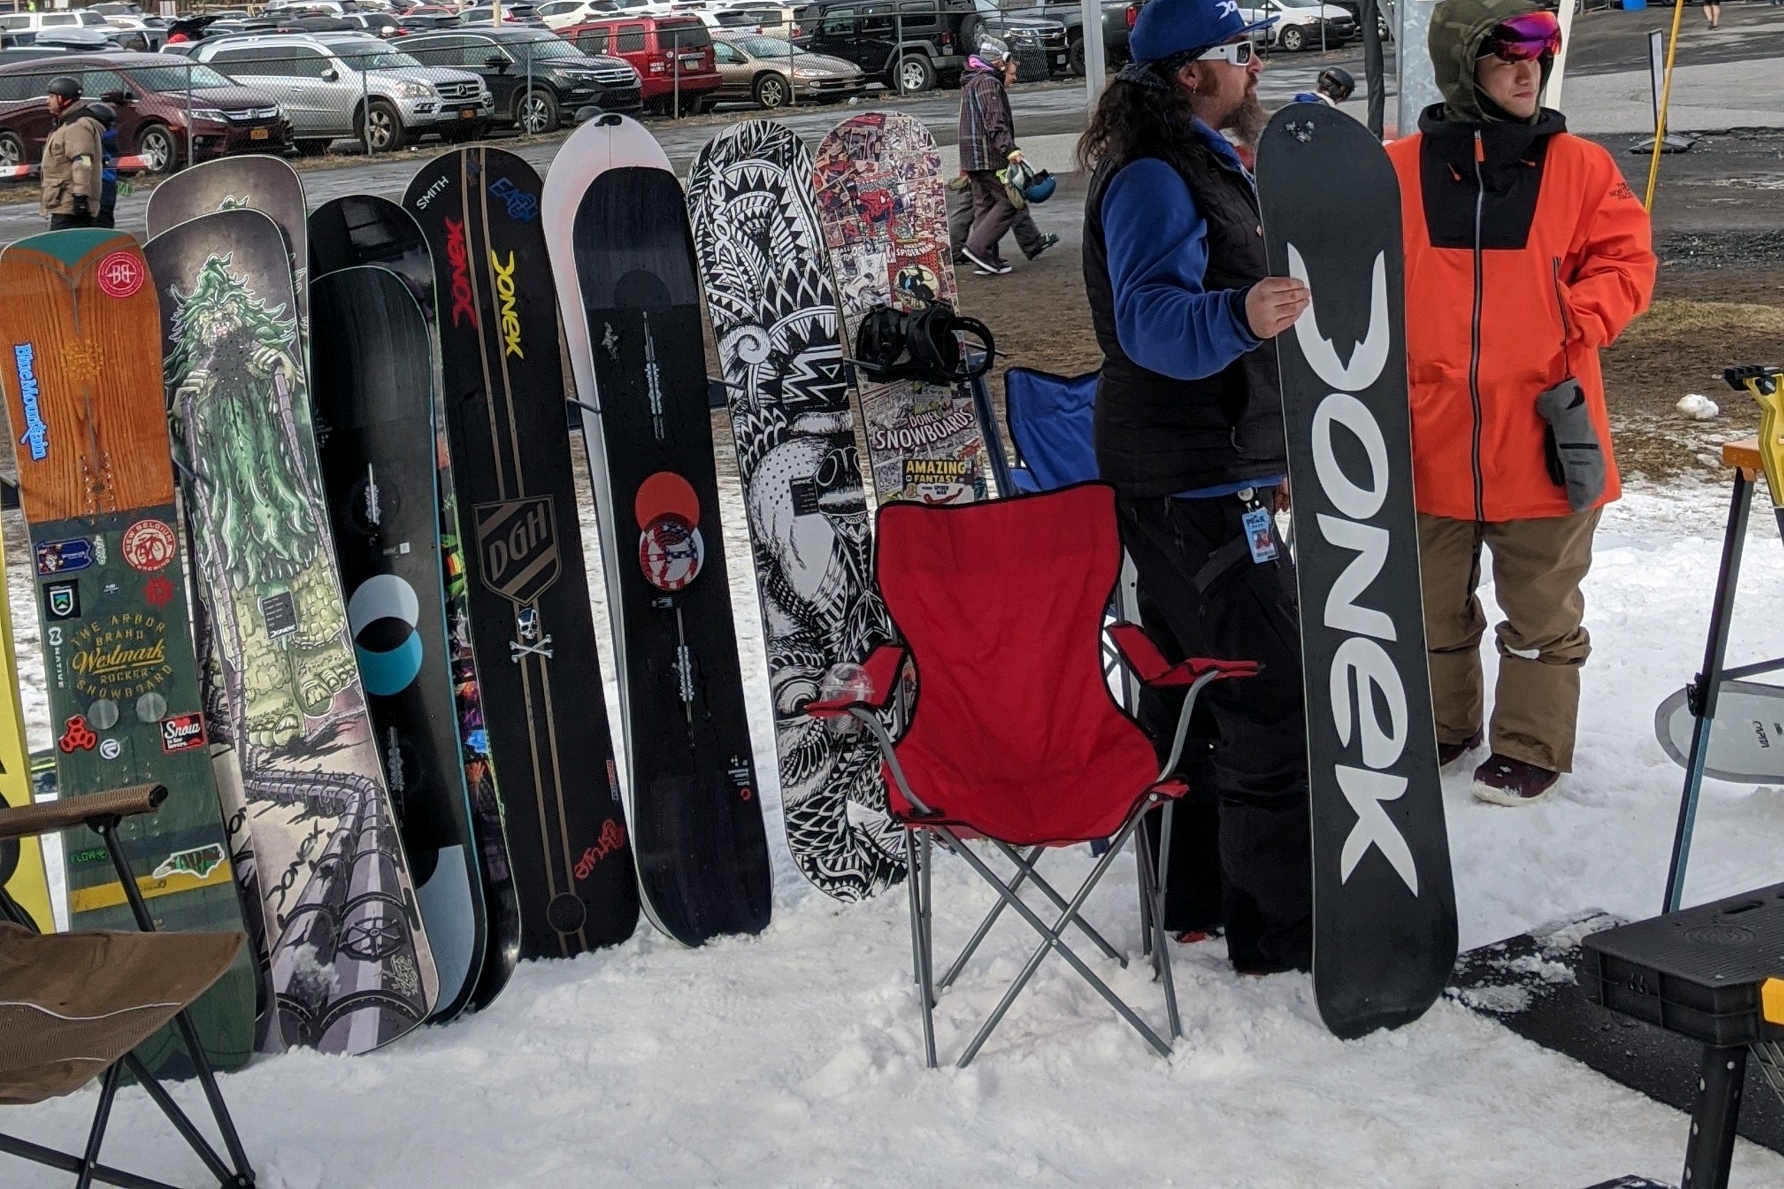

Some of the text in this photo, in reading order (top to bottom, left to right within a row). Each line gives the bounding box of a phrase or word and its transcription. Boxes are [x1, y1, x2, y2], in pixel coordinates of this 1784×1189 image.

[416, 175, 450, 210] SMITH
[876, 409, 975, 450] SNOWBOARDS
[909, 411, 942, 428] DONEK
[906, 460, 967, 475] AMAZING
[914, 475, 958, 483] FANTASY
[125, 530, 135, 553] NEW
[136, 523, 174, 546] BELGIUM
[489, 502, 548, 583] DGH
[71, 613, 166, 647] THE ARBOR
[96, 628, 144, 647] BRAND
[54, 647, 65, 689] NATIVE
[71, 638, 166, 676] Westmark
[76, 664, 173, 699] SNOWBOARD
[100, 668, 149, 685] ROCKER
[165, 720, 201, 739] Snow
